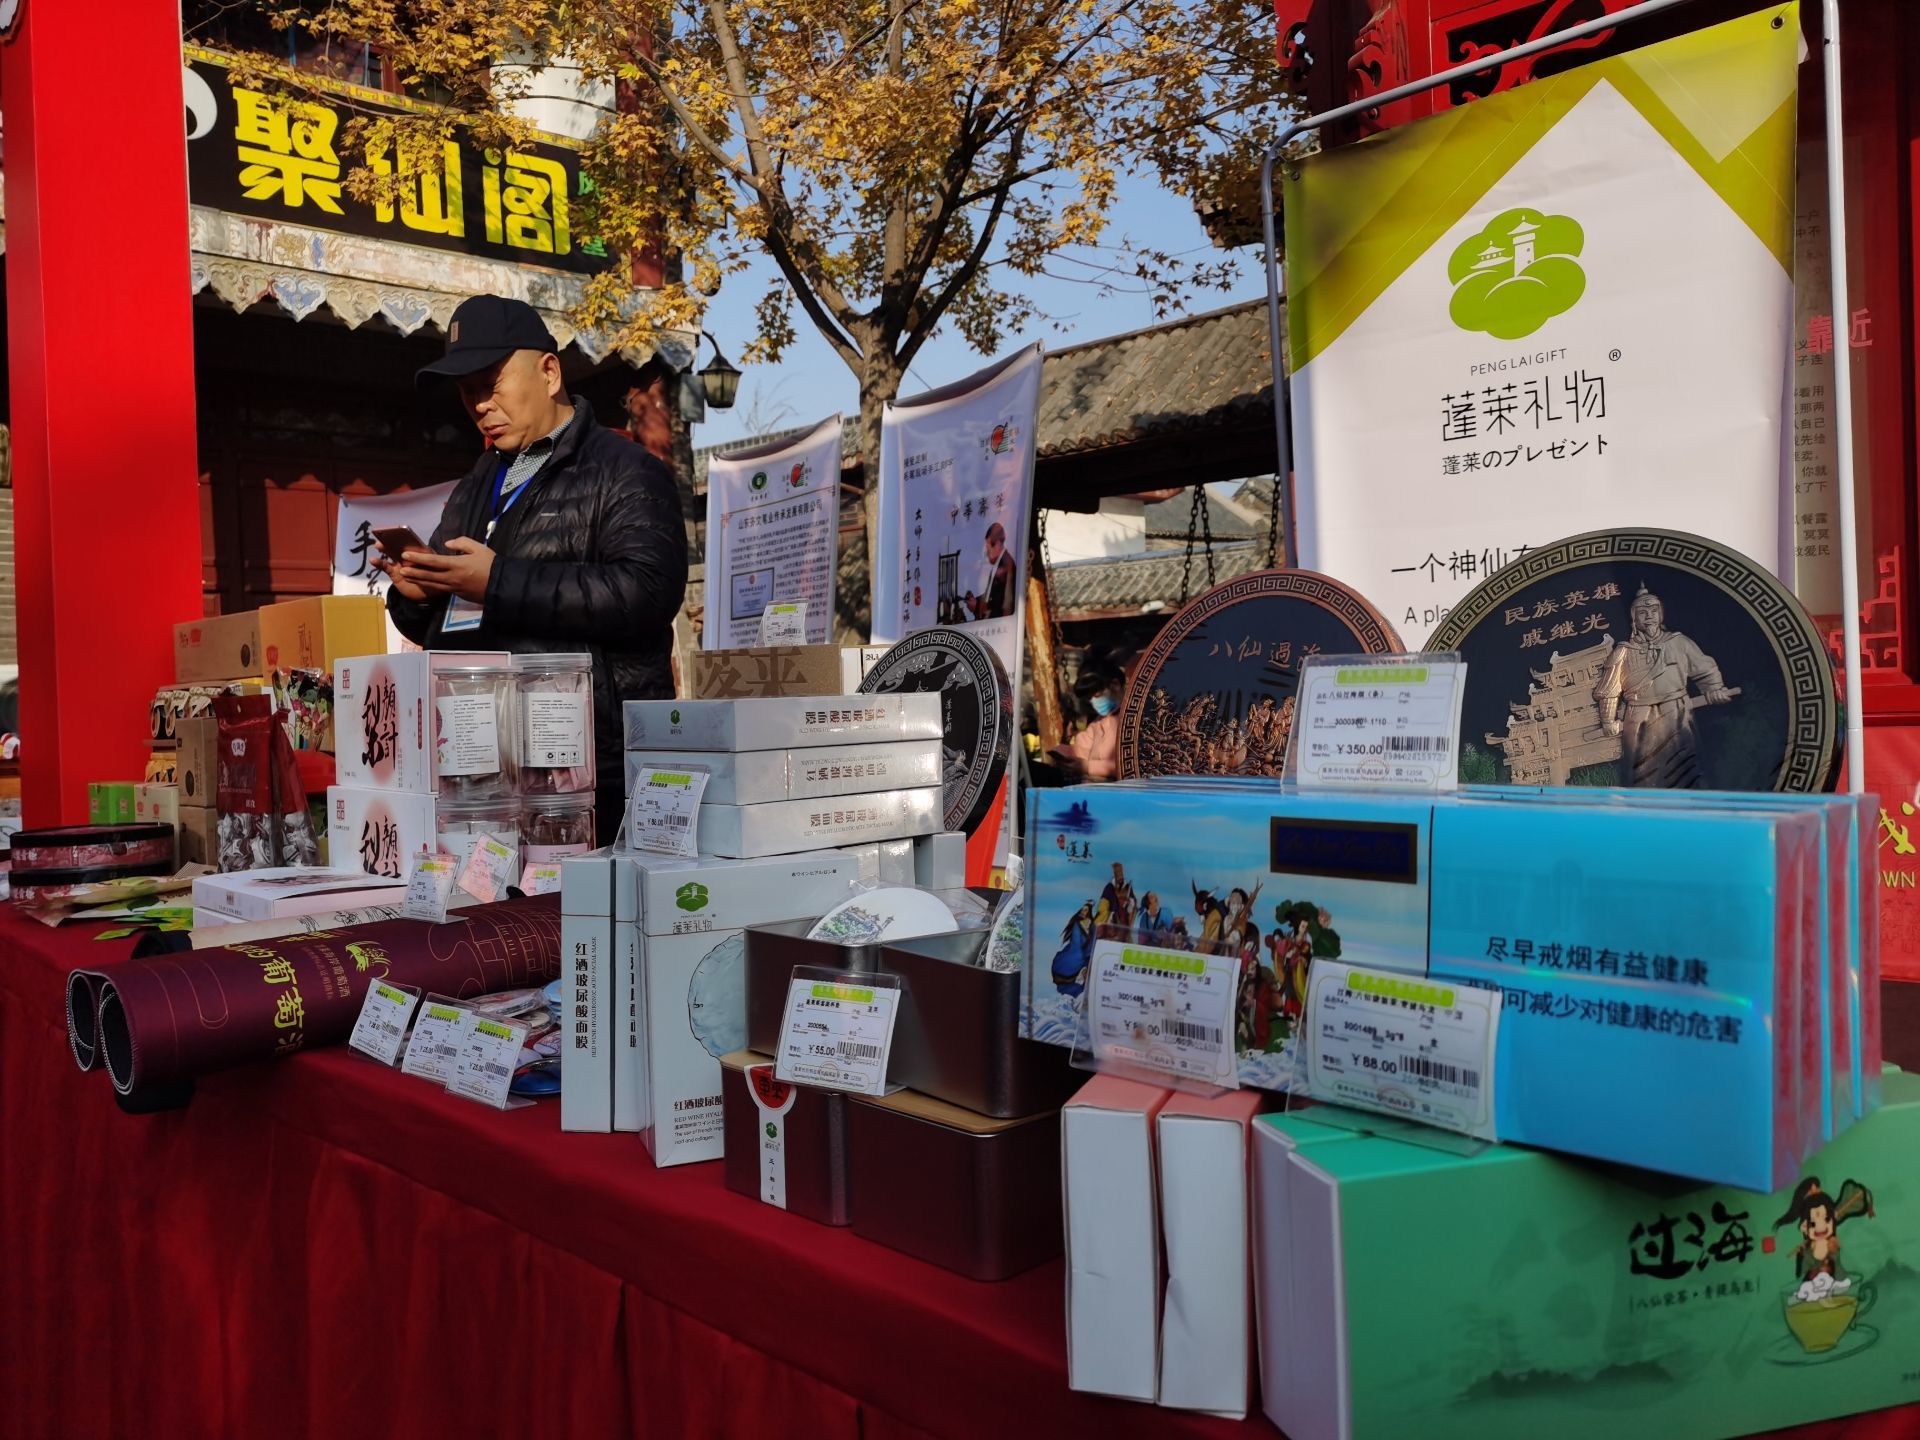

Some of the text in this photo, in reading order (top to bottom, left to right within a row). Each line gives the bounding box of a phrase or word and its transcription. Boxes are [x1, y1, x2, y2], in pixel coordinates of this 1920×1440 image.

[1440, 369, 1606, 442] 蓬莱礼物
[1441, 433, 1609, 476] 蓬莱のプレゼント
[1403, 606, 1418, 625] A
[1503, 581, 1622, 627] 民族英雄
[1519, 612, 1611, 649] 戚继光
[1336, 744, 1383, 756] ¥350.00
[1485, 935, 1709, 987] 尽早戒烟有益健康
[575, 942, 588, 1050] 红酒玻尿酸面膜
[1351, 1053, 1397, 1075] ¥88.00
[1627, 1200, 1755, 1280] 过海
